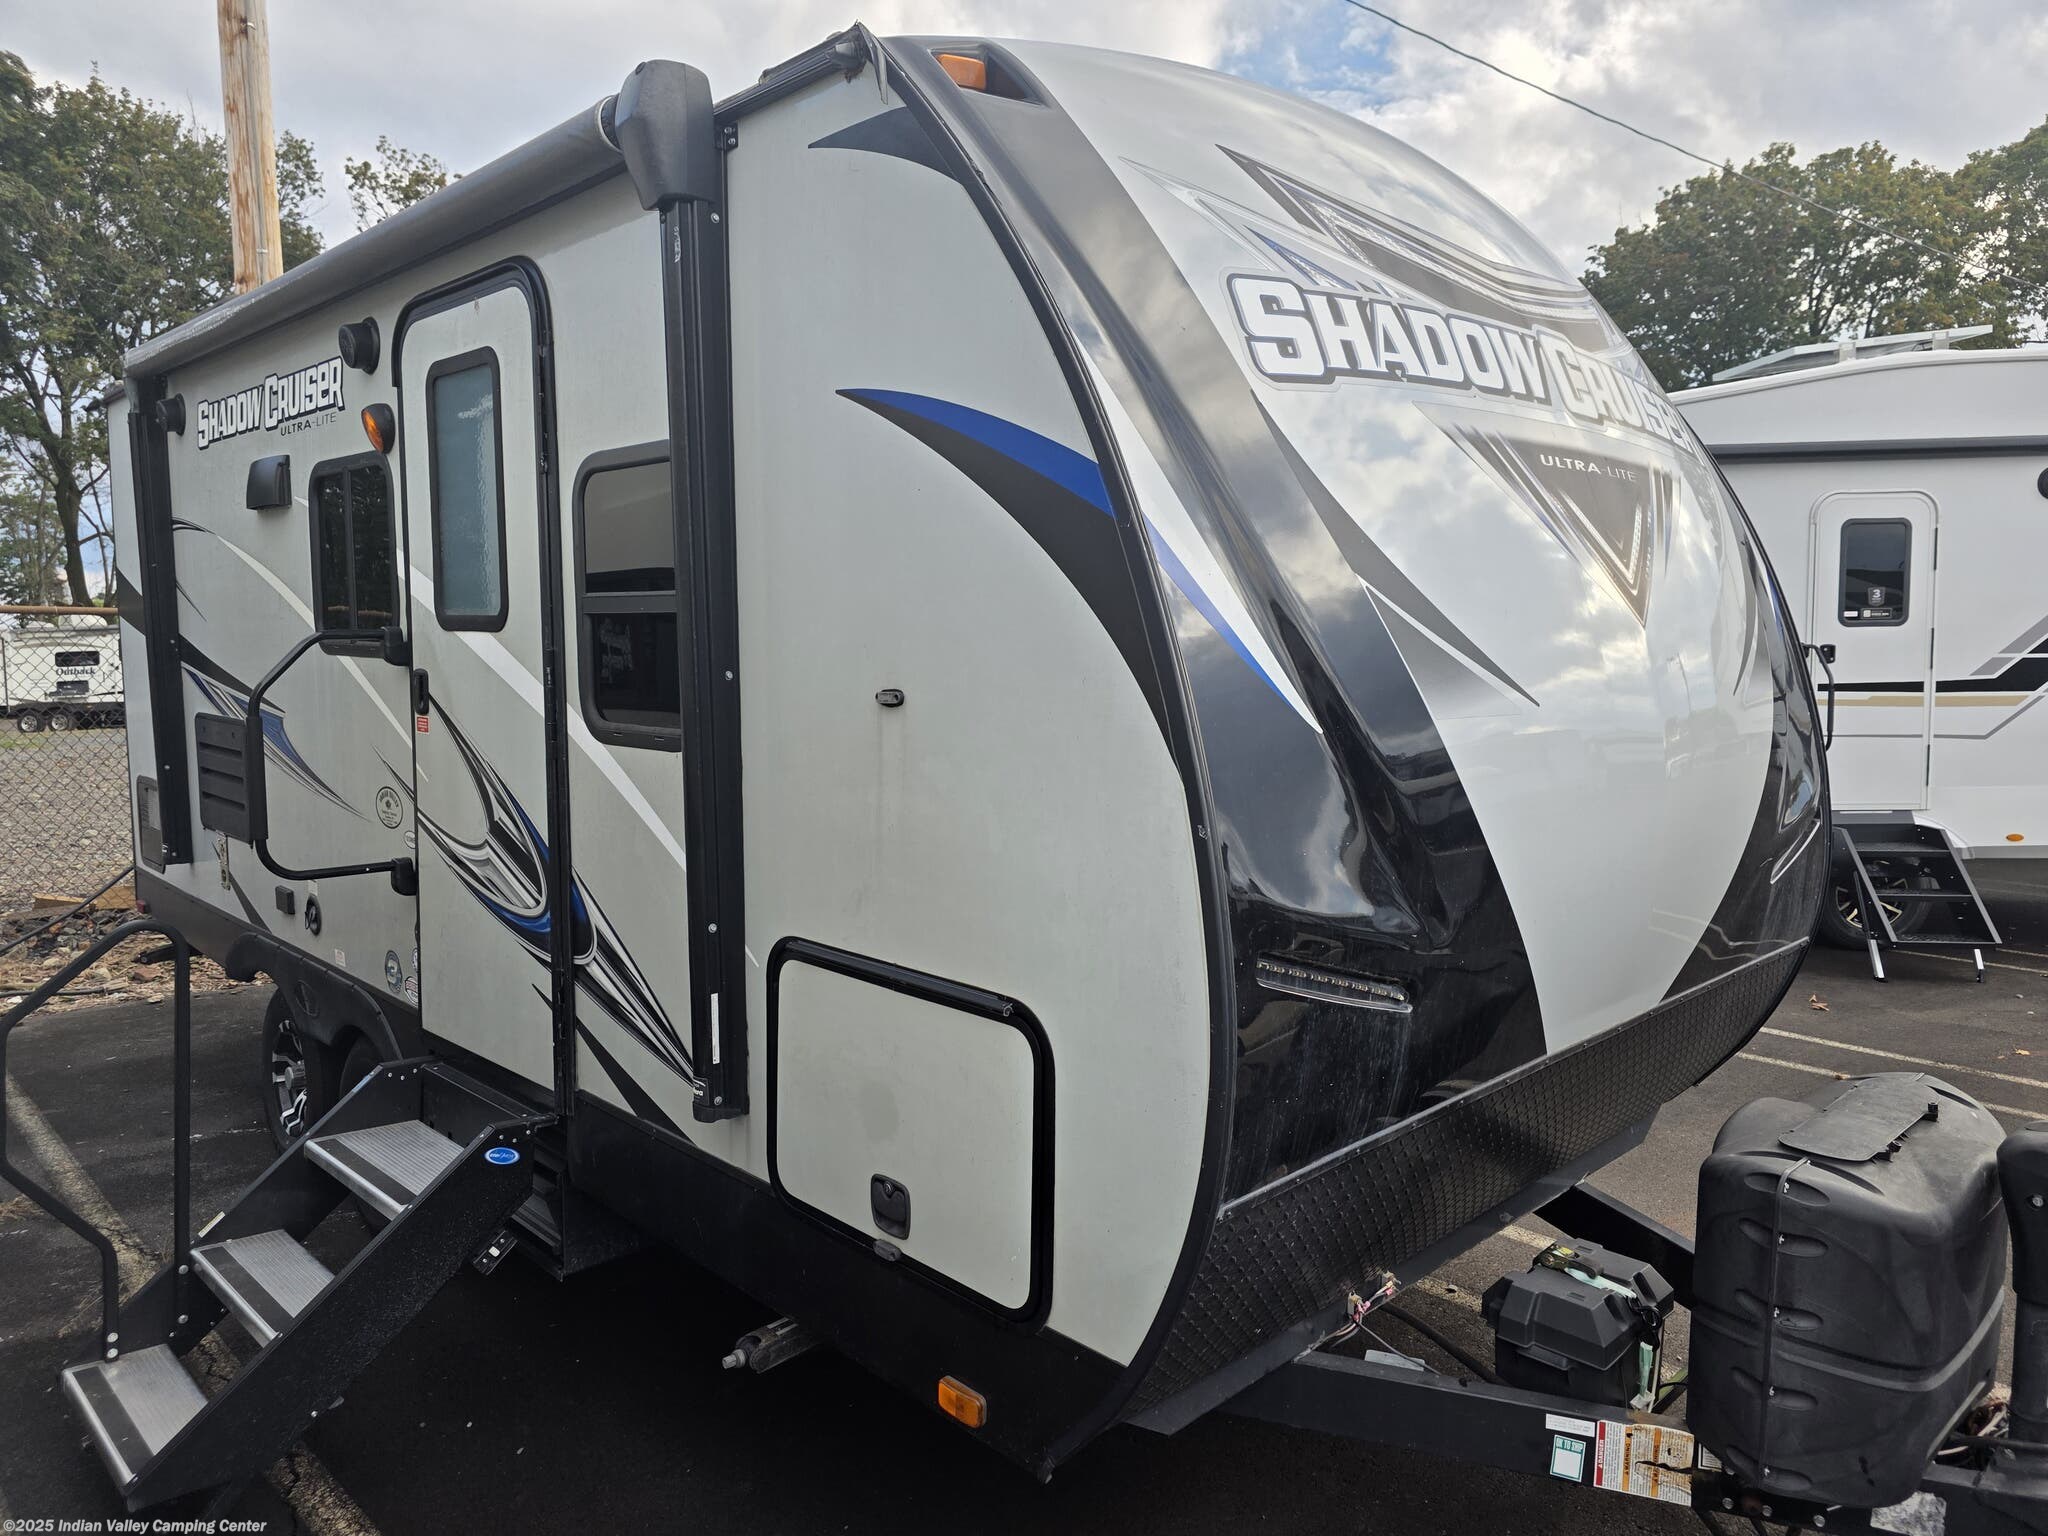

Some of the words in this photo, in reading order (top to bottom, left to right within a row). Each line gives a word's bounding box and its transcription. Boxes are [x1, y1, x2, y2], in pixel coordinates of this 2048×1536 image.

[1227, 273, 1551, 407] SHADOW
[198, 385, 264, 450] SHADOW
[264, 356, 345, 431] CRUISER
[281, 413, 337, 436] ULTRA-LITE
[1540, 454, 1638, 482] ULTRA-LITE
[1872, 589, 1881, 597] 3
[56, 667, 96, 676] Outback
